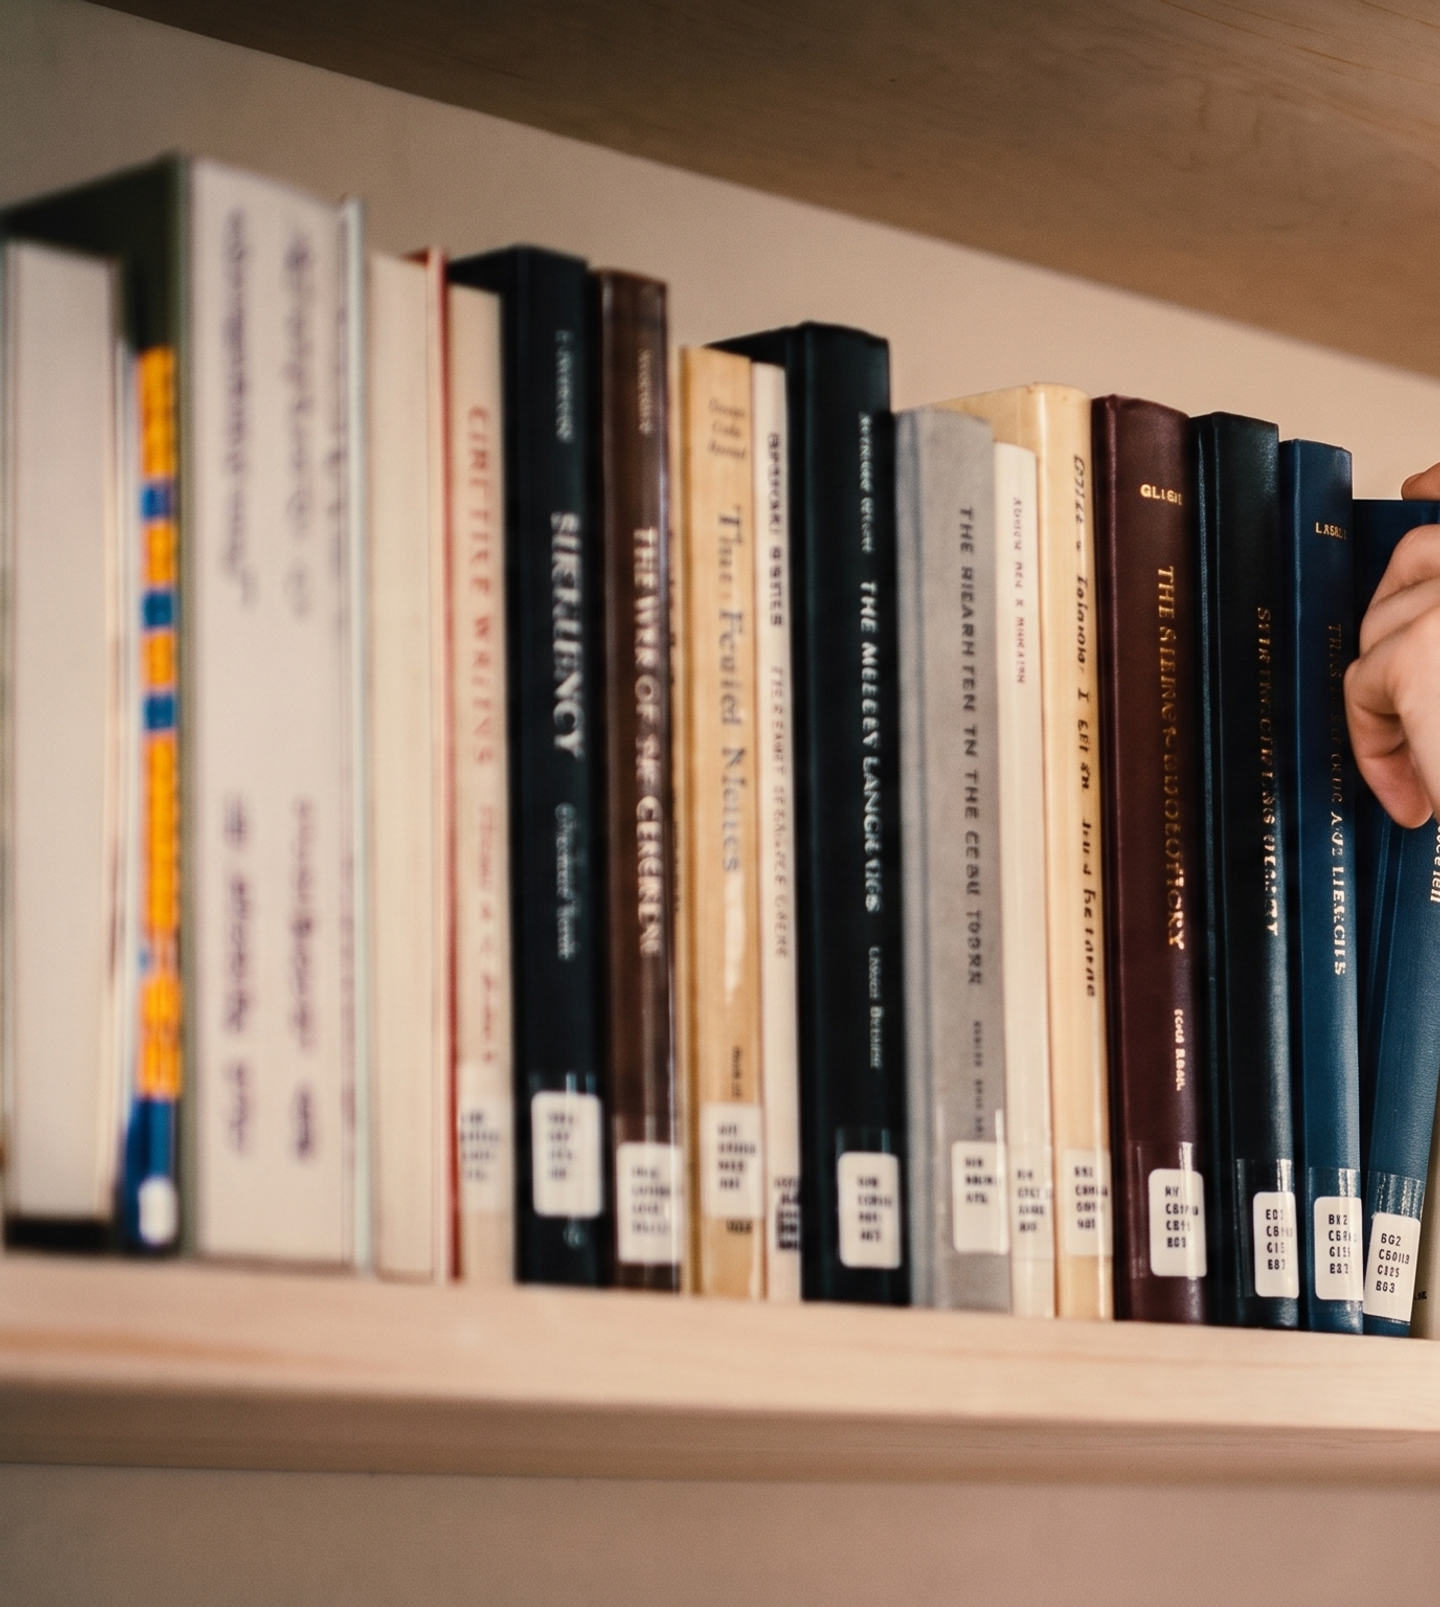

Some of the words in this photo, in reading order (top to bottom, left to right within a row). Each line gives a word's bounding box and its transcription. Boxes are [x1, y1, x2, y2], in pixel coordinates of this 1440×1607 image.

[959, 507, 976, 555] THE
[1158, 565, 1175, 619] THE
[964, 770, 980, 819] THE
